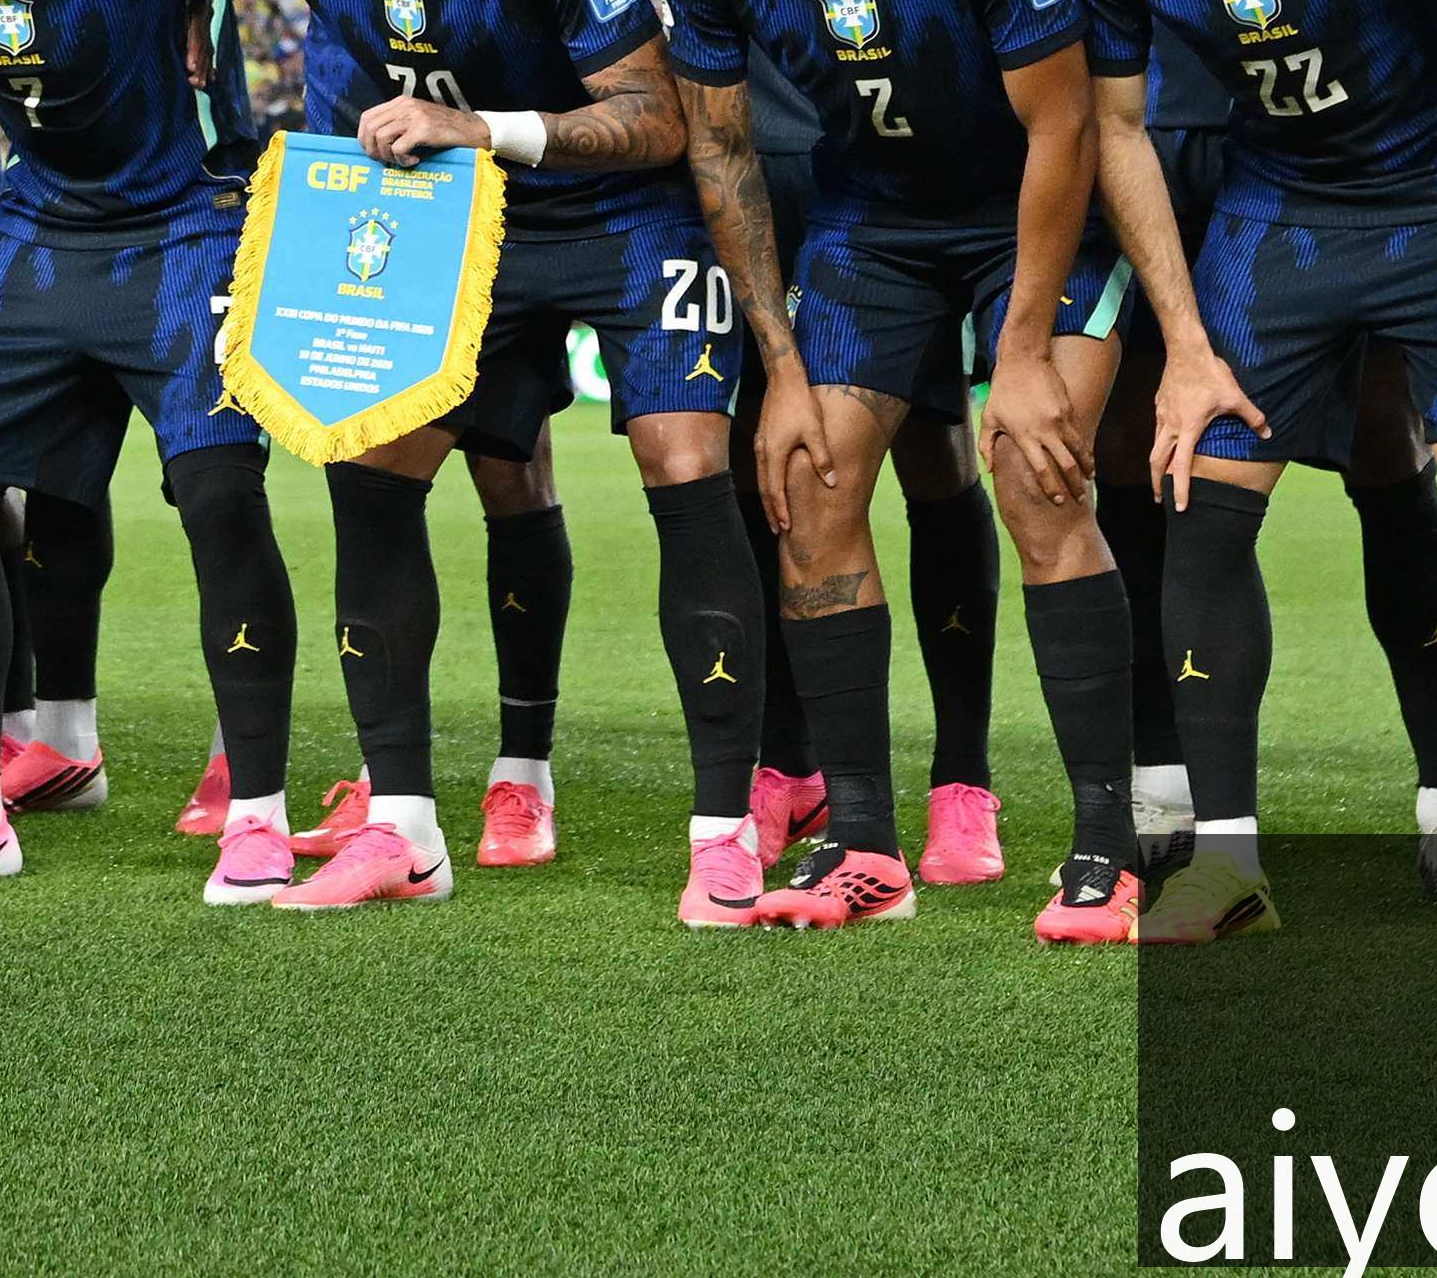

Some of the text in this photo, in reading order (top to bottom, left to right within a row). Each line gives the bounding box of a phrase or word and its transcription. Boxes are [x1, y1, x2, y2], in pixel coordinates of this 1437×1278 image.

[0, 14, 18, 23] CBF
[839, 6, 861, 16] CBF
[1237, 22, 1300, 46] BRASIL
[388, 37, 439, 54] BRASIL
[835, 46, 893, 62] BRASIL
[1240, 47, 1350, 117] 22
[7, 76, 44, 128] 7
[854, 77, 915, 138] 2
[307, 160, 372, 193] CBF
[381, 177, 435, 190] BRASILEIRA
[382, 168, 453, 183] CONFEDERAÇÃO
[394, 188, 435, 200] FUTEBOL
[337, 282, 385, 300] BRASIL
[661, 258, 734, 335] 20
[308, 363, 377, 381] PHILADELPHIA
